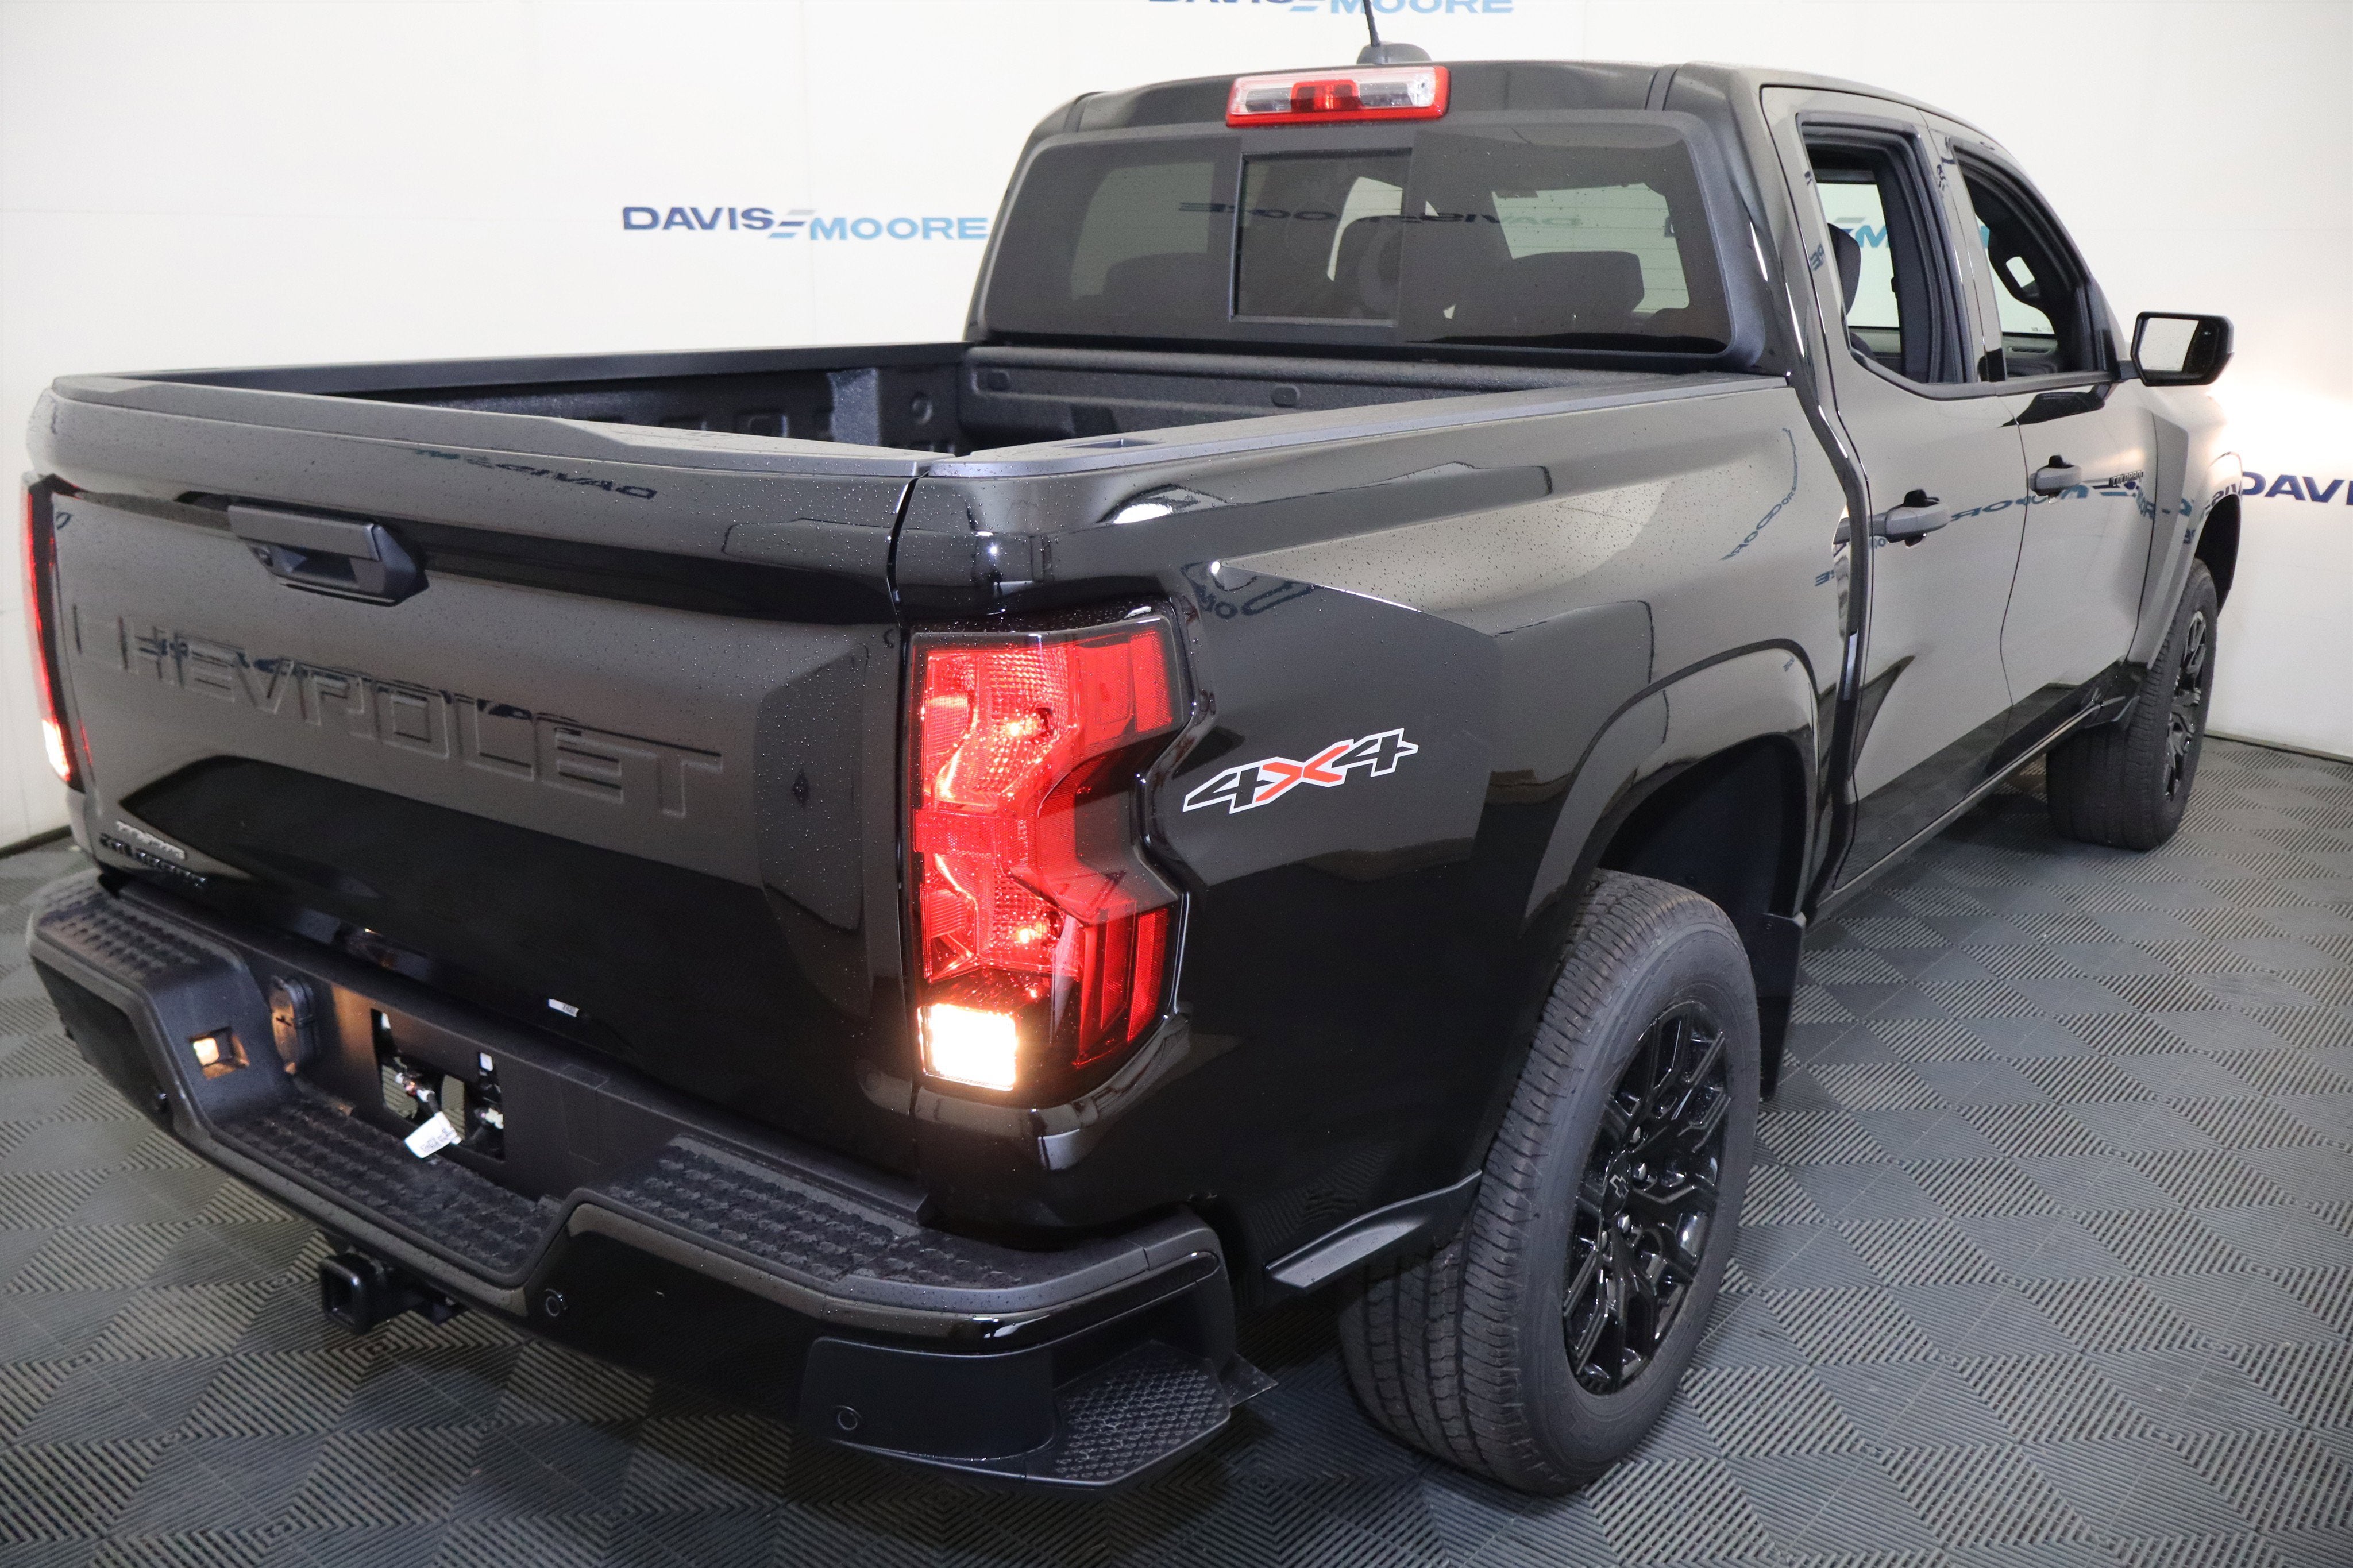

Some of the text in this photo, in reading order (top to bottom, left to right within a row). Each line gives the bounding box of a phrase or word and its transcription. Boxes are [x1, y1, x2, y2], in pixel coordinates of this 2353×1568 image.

[623, 207, 989, 241] DAVIS MOORE
[71, 603, 723, 819] CHEVROLET
